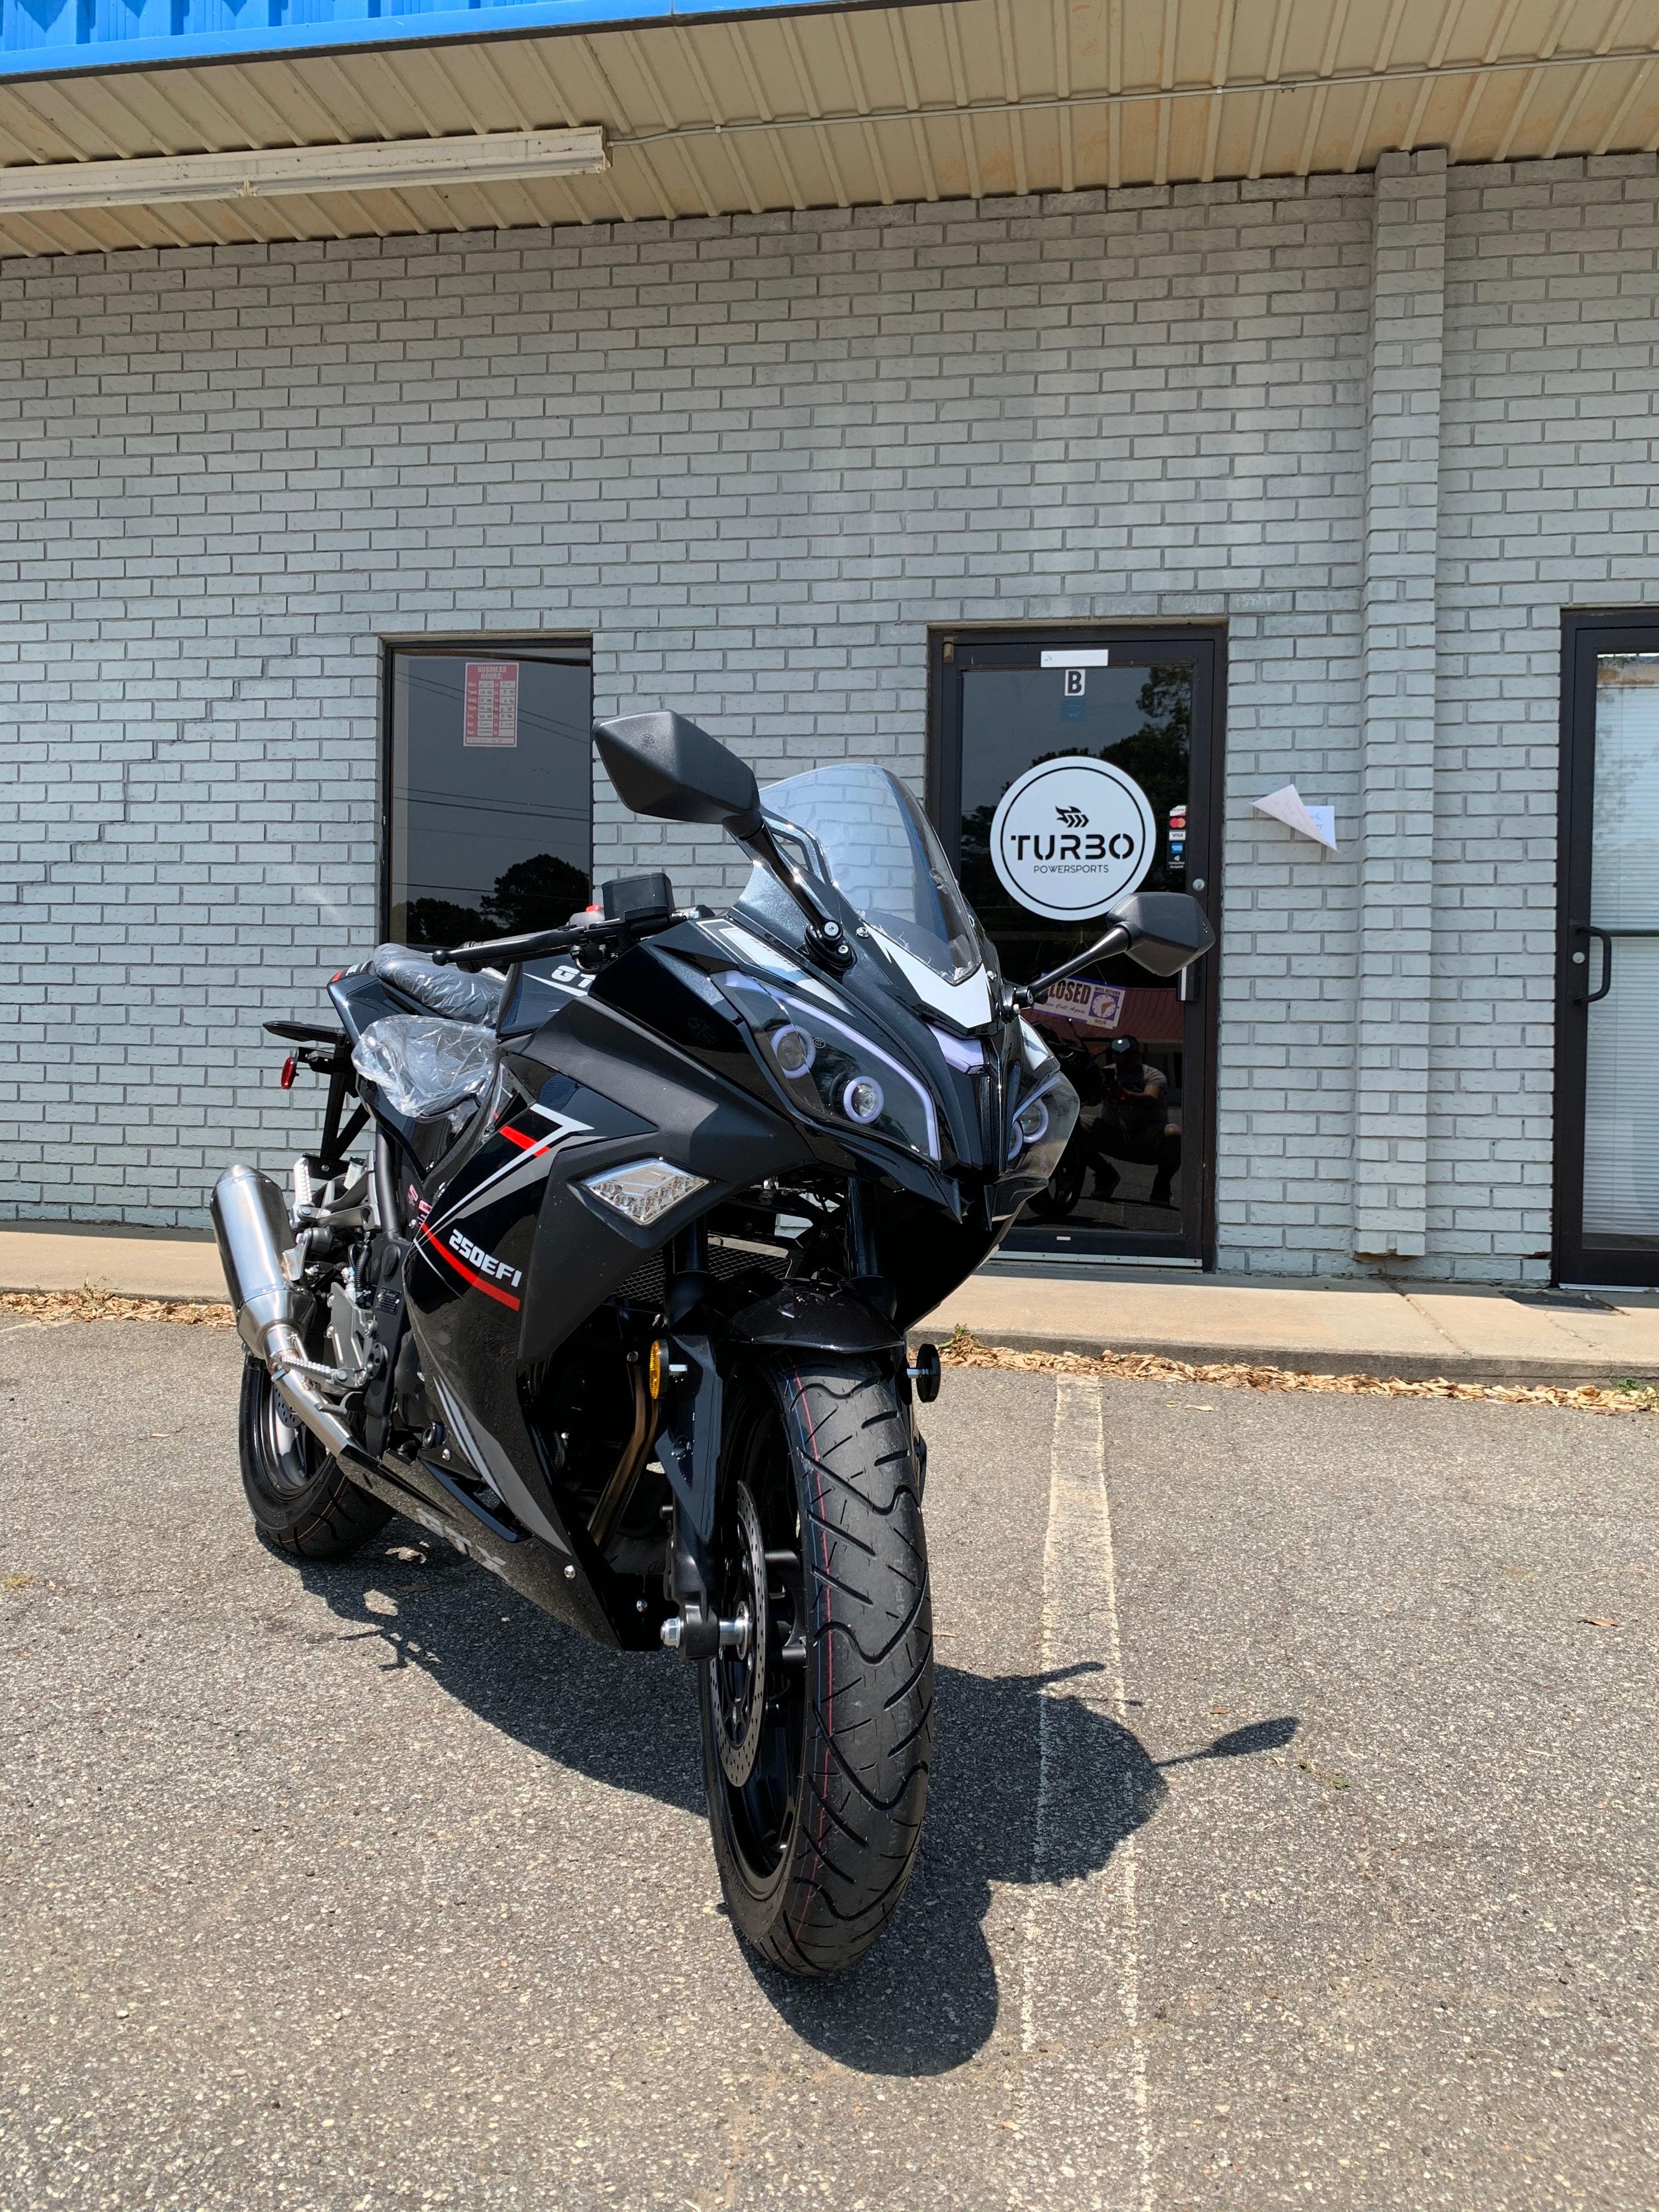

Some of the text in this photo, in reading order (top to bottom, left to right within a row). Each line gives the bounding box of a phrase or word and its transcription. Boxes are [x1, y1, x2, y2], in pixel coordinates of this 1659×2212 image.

[1068, 670, 1082, 694] B
[1011, 833, 1135, 861] TURBO
[1033, 864, 1109, 874] POWERSPORTS
[1048, 979, 1092, 1005] LOSED
[449, 1228, 522, 1288] 250EFI
